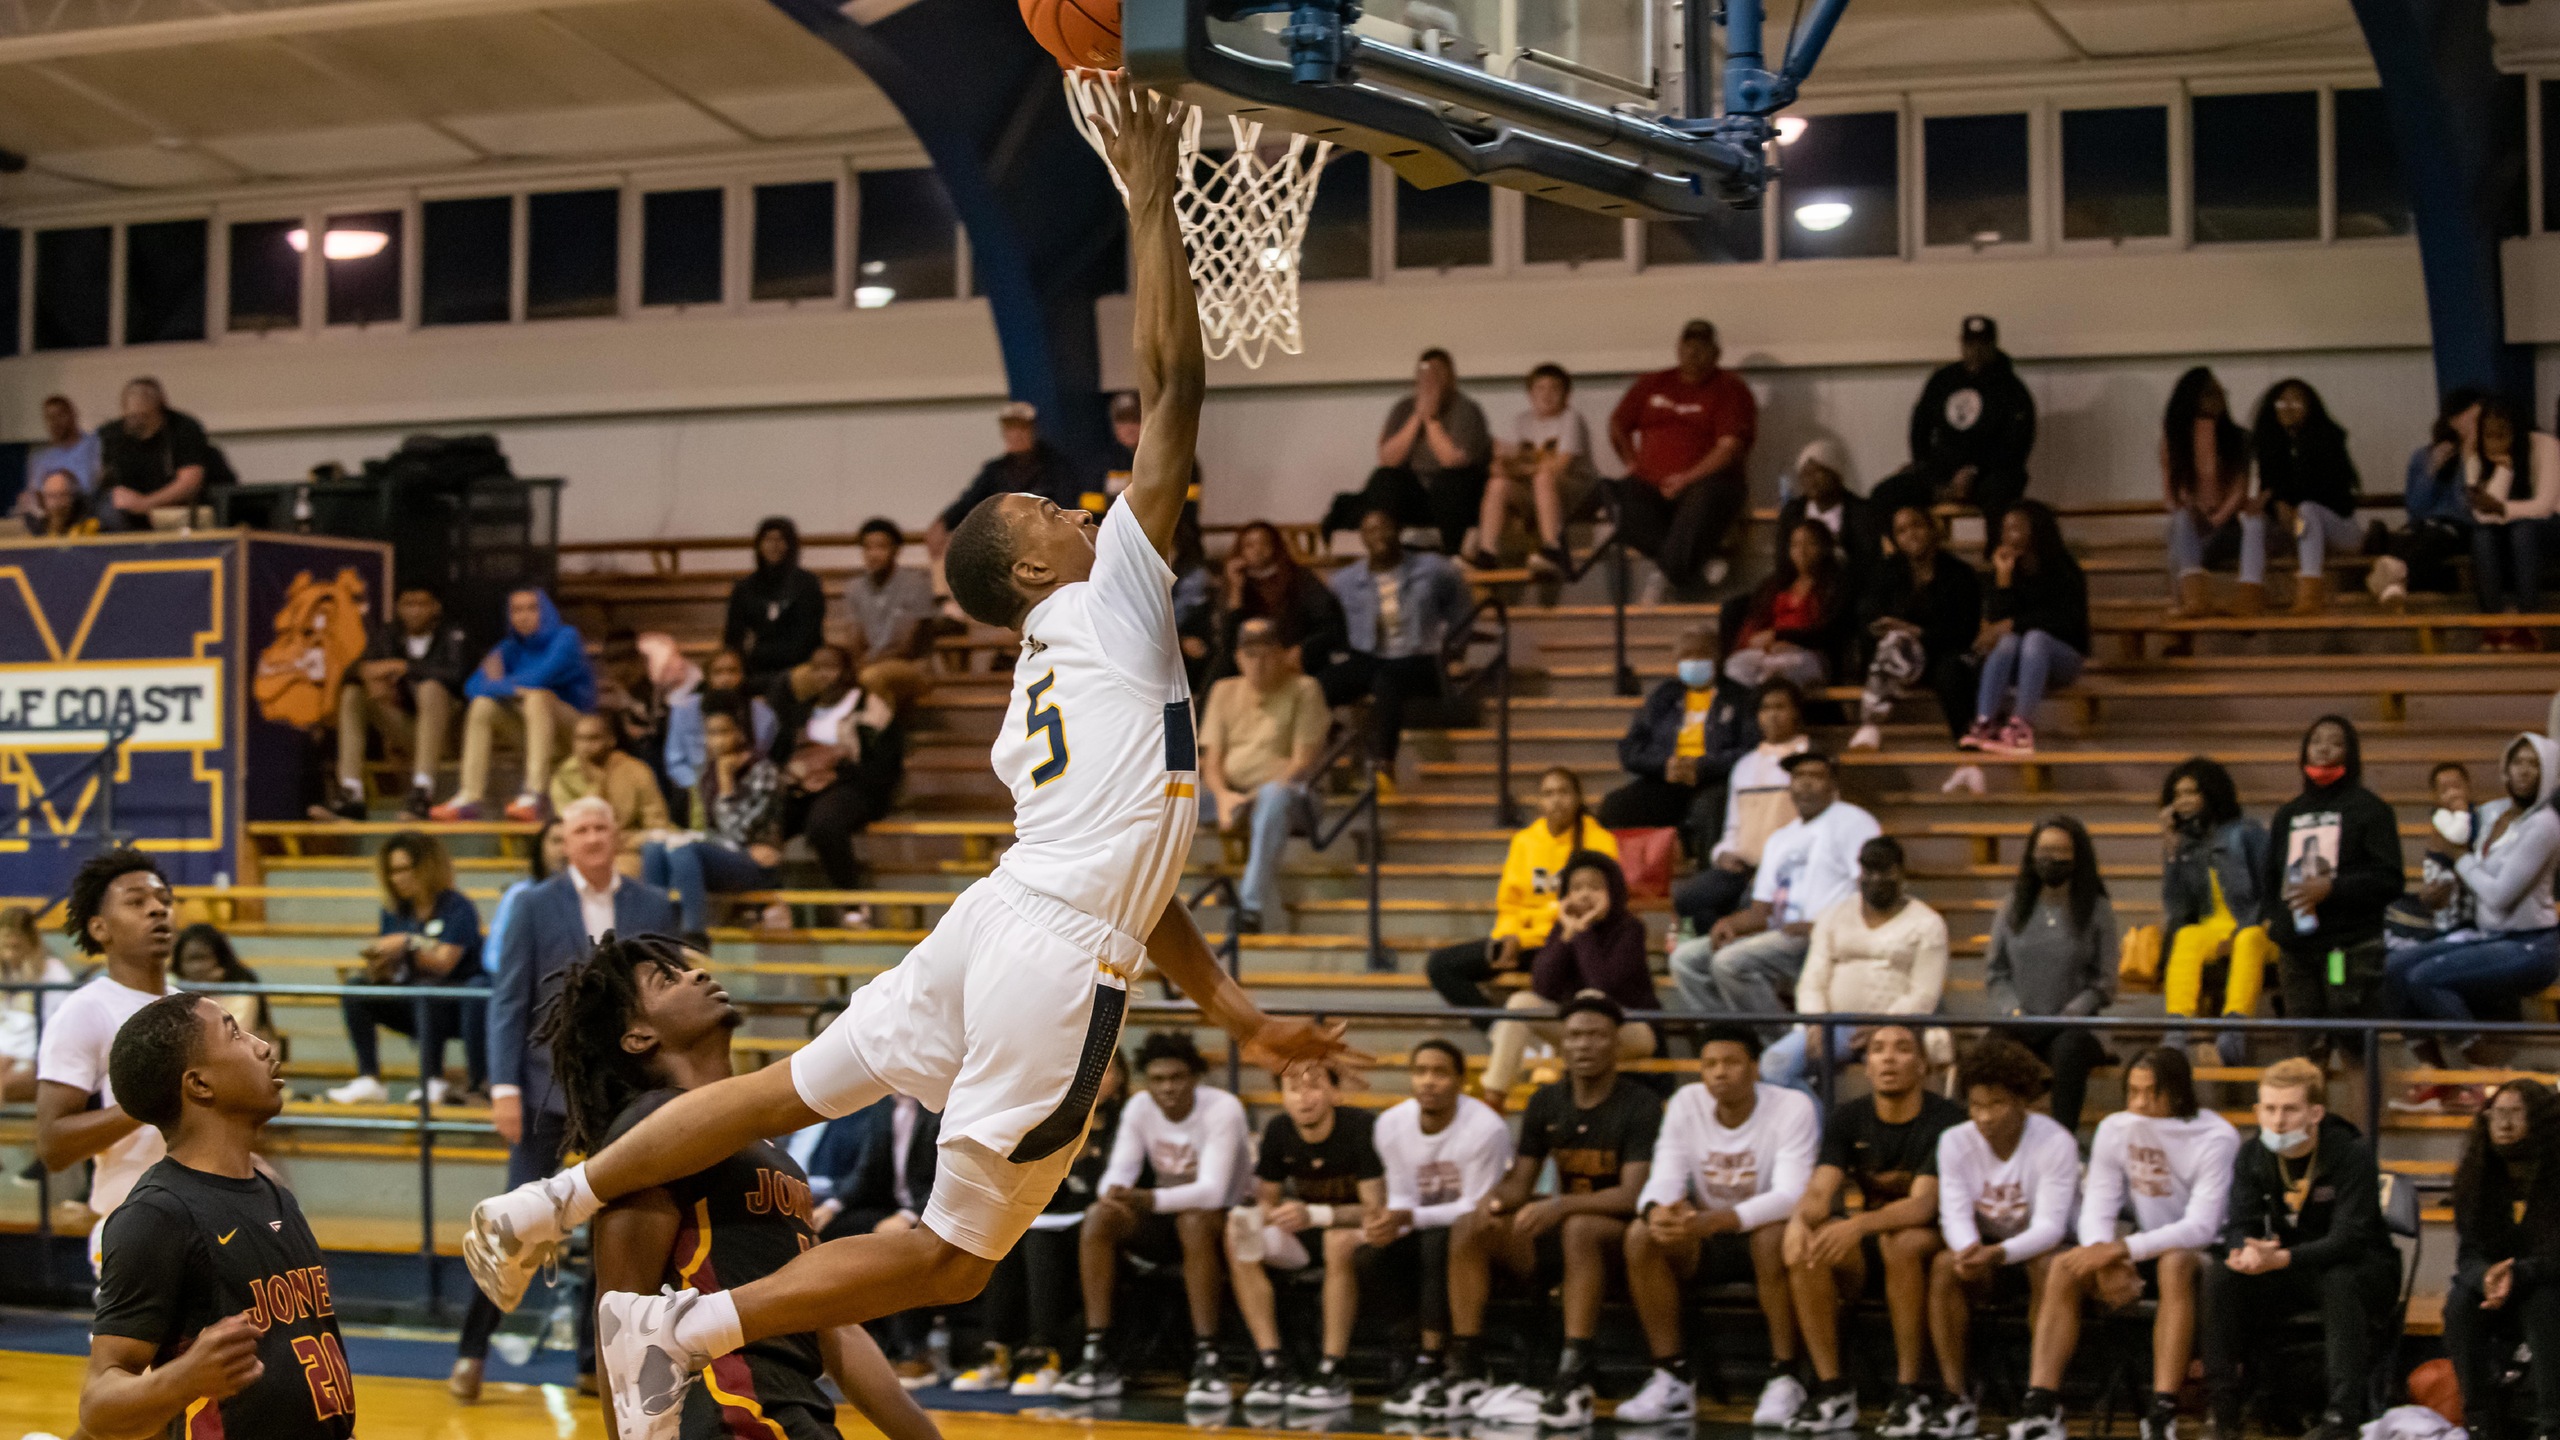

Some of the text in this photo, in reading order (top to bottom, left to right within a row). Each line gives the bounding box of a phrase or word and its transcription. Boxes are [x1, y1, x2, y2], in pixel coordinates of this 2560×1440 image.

[55, 684, 203, 730] COAST
[1025, 666, 1071, 790] 5
[243, 1265, 336, 1333] JONE
